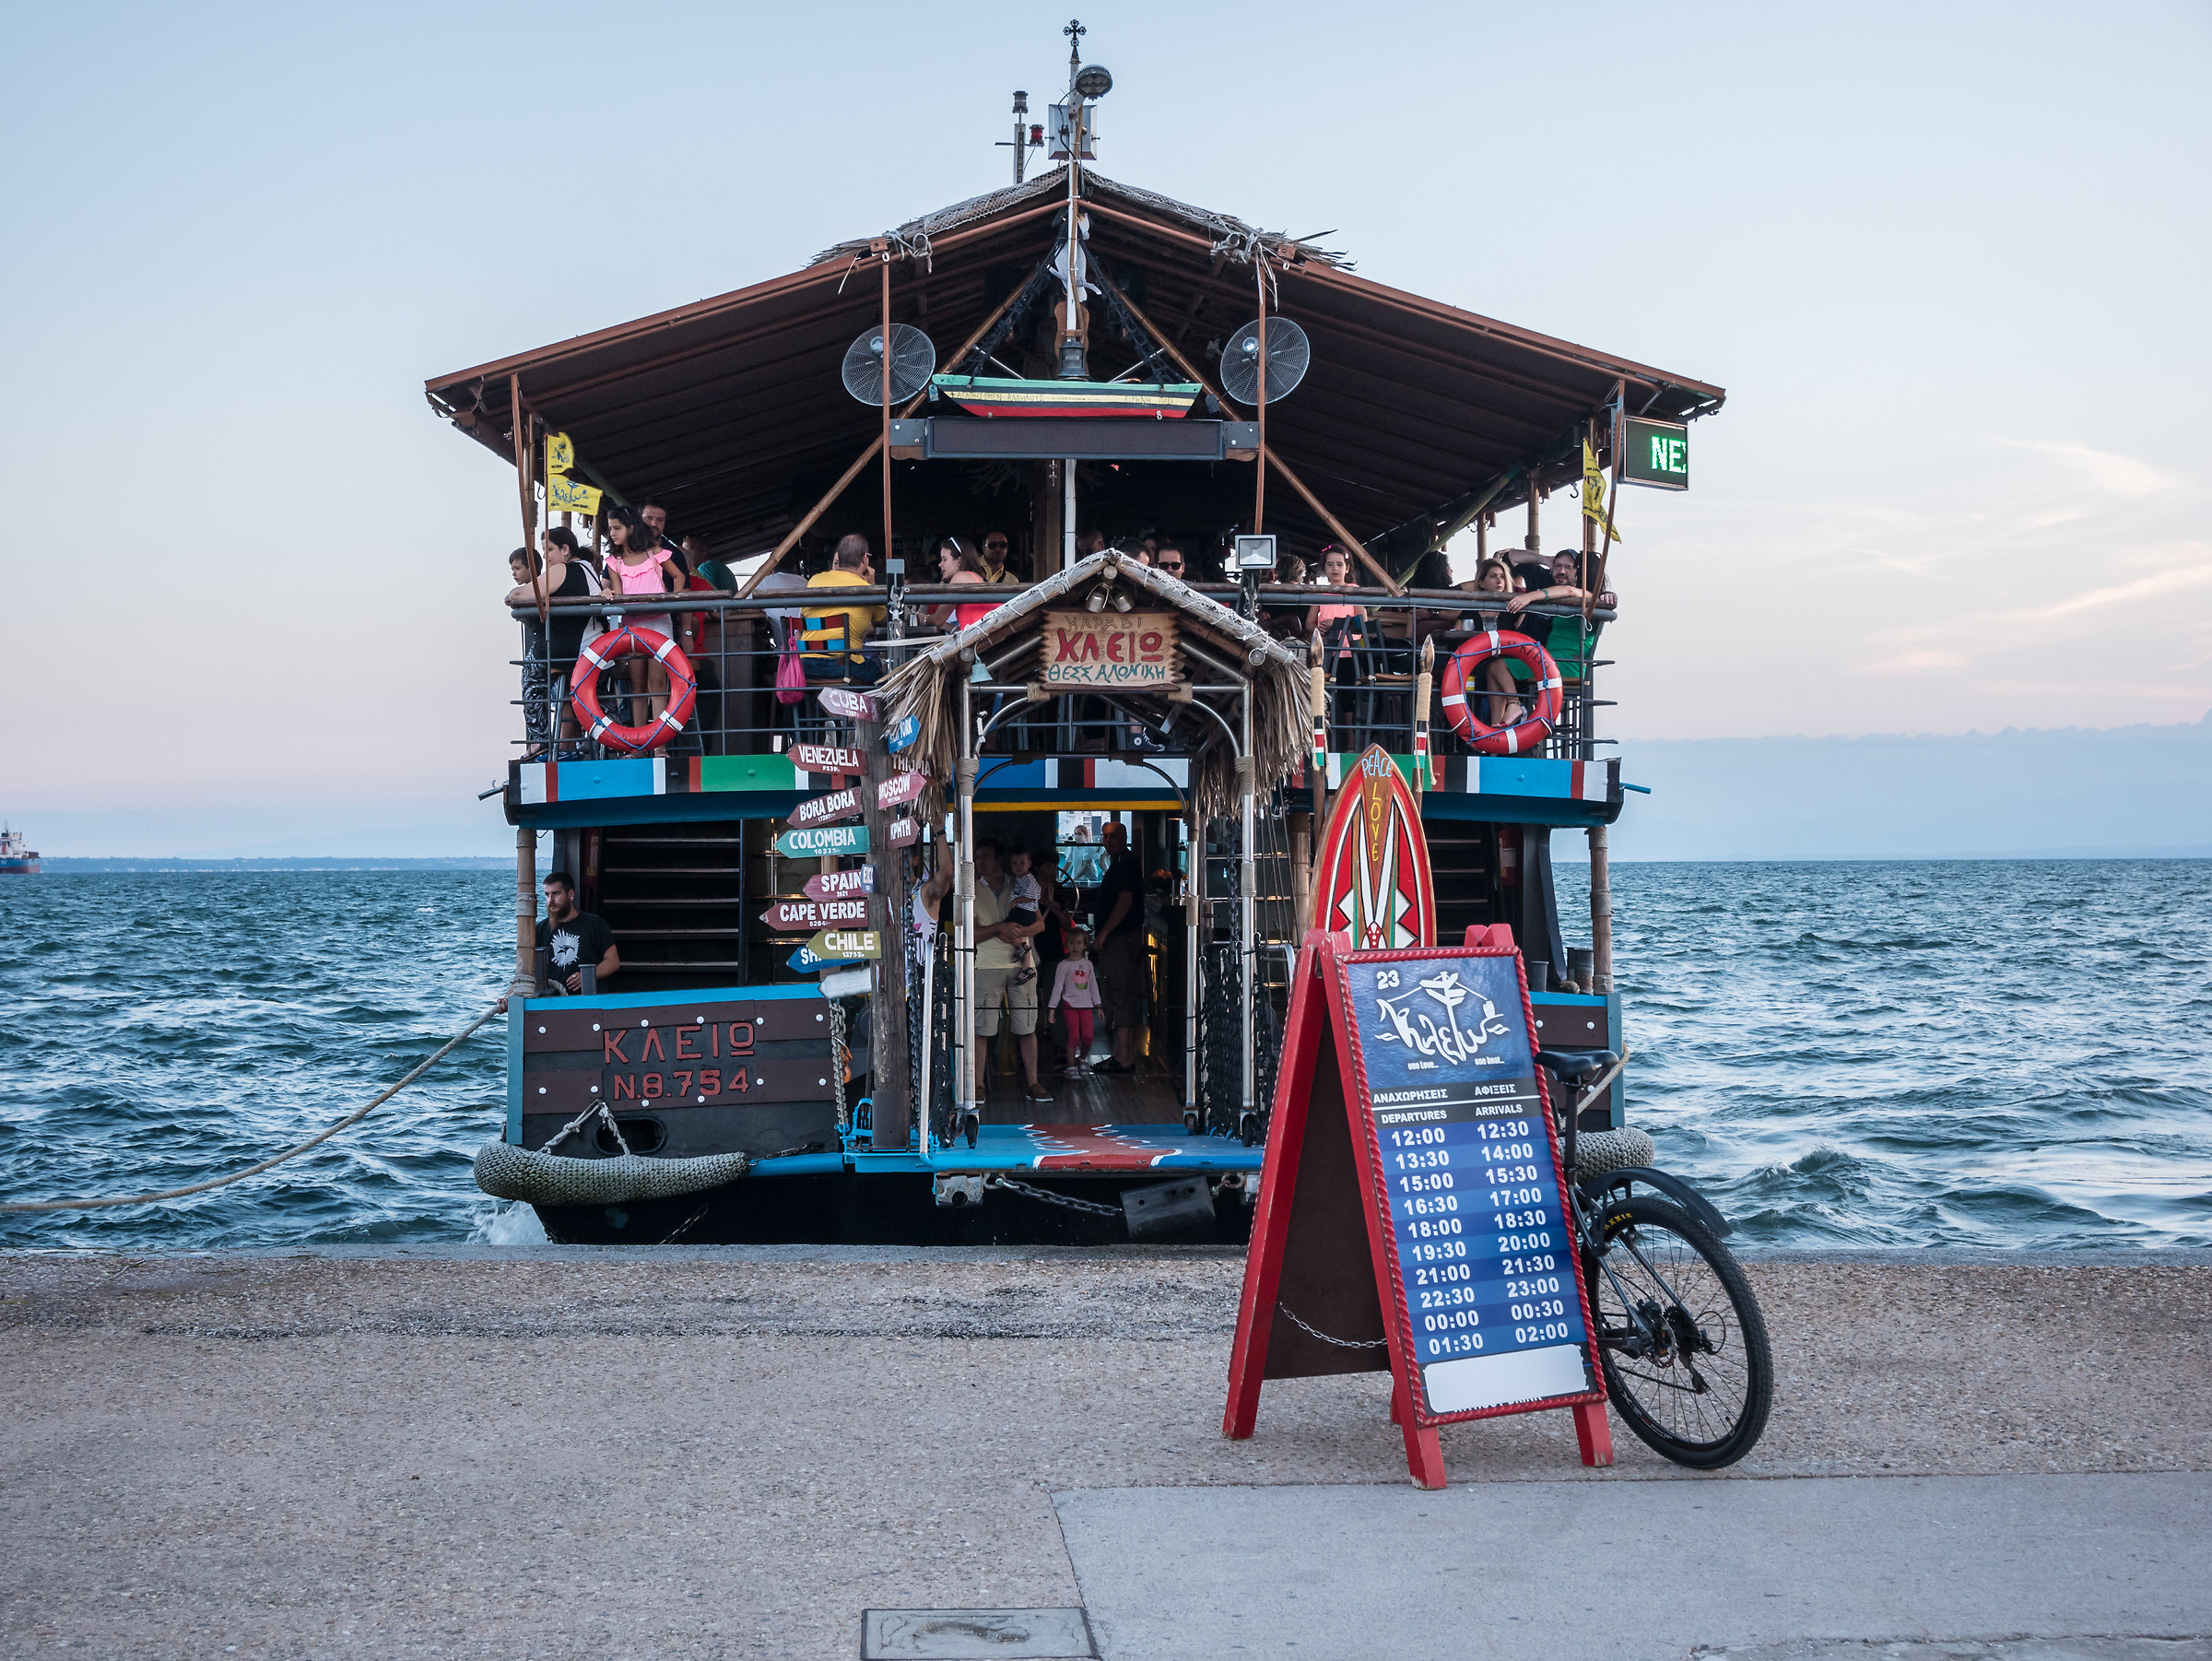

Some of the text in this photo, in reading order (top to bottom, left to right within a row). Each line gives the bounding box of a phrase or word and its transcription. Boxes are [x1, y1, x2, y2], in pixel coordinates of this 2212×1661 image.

[1651, 436, 1686, 474] NE
[830, 689, 868, 714] CUBA
[798, 745, 860, 768] VENEZUELA
[1361, 749, 1394, 778] PEACE
[878, 774, 911, 801] MOSCOW
[799, 790, 856, 822] BORA BORA
[1371, 782, 1382, 862] LOVE
[789, 829, 856, 850] COLOMBIA
[820, 870, 862, 892] SPAIN
[780, 901, 865, 922] CAPE VERDE
[824, 933, 875, 950] CHILE
[801, 948, 822, 965] SH
[1376, 970, 1400, 990] 23
[1373, 1084, 1516, 1104] ΑΝΑΧΩΡΗΣΕΙΣ ΑΦΙΞΕΙΣ
[1381, 1104, 1524, 1125] DEPARTURES ARRIVALS
[1391, 1121, 1529, 1147] 12:00 12:30
[1395, 1143, 1534, 1170] 13:30 14:00
[1399, 1165, 1538, 1193] 15:00 15:30
[1404, 1187, 1542, 1216] 16:30 17:00
[1407, 1209, 1547, 1239] 18:00 18:30
[1605, 1213, 1632, 1231] AXXIS
[1412, 1232, 1550, 1262] 19:30 20:00
[1416, 1255, 1556, 1285] 21:00 21:30
[1420, 1278, 1559, 1308] 22:30 23:00
[1424, 1300, 1564, 1332] 00:00 00:30
[1429, 1322, 1569, 1355] 01:30 02:00
